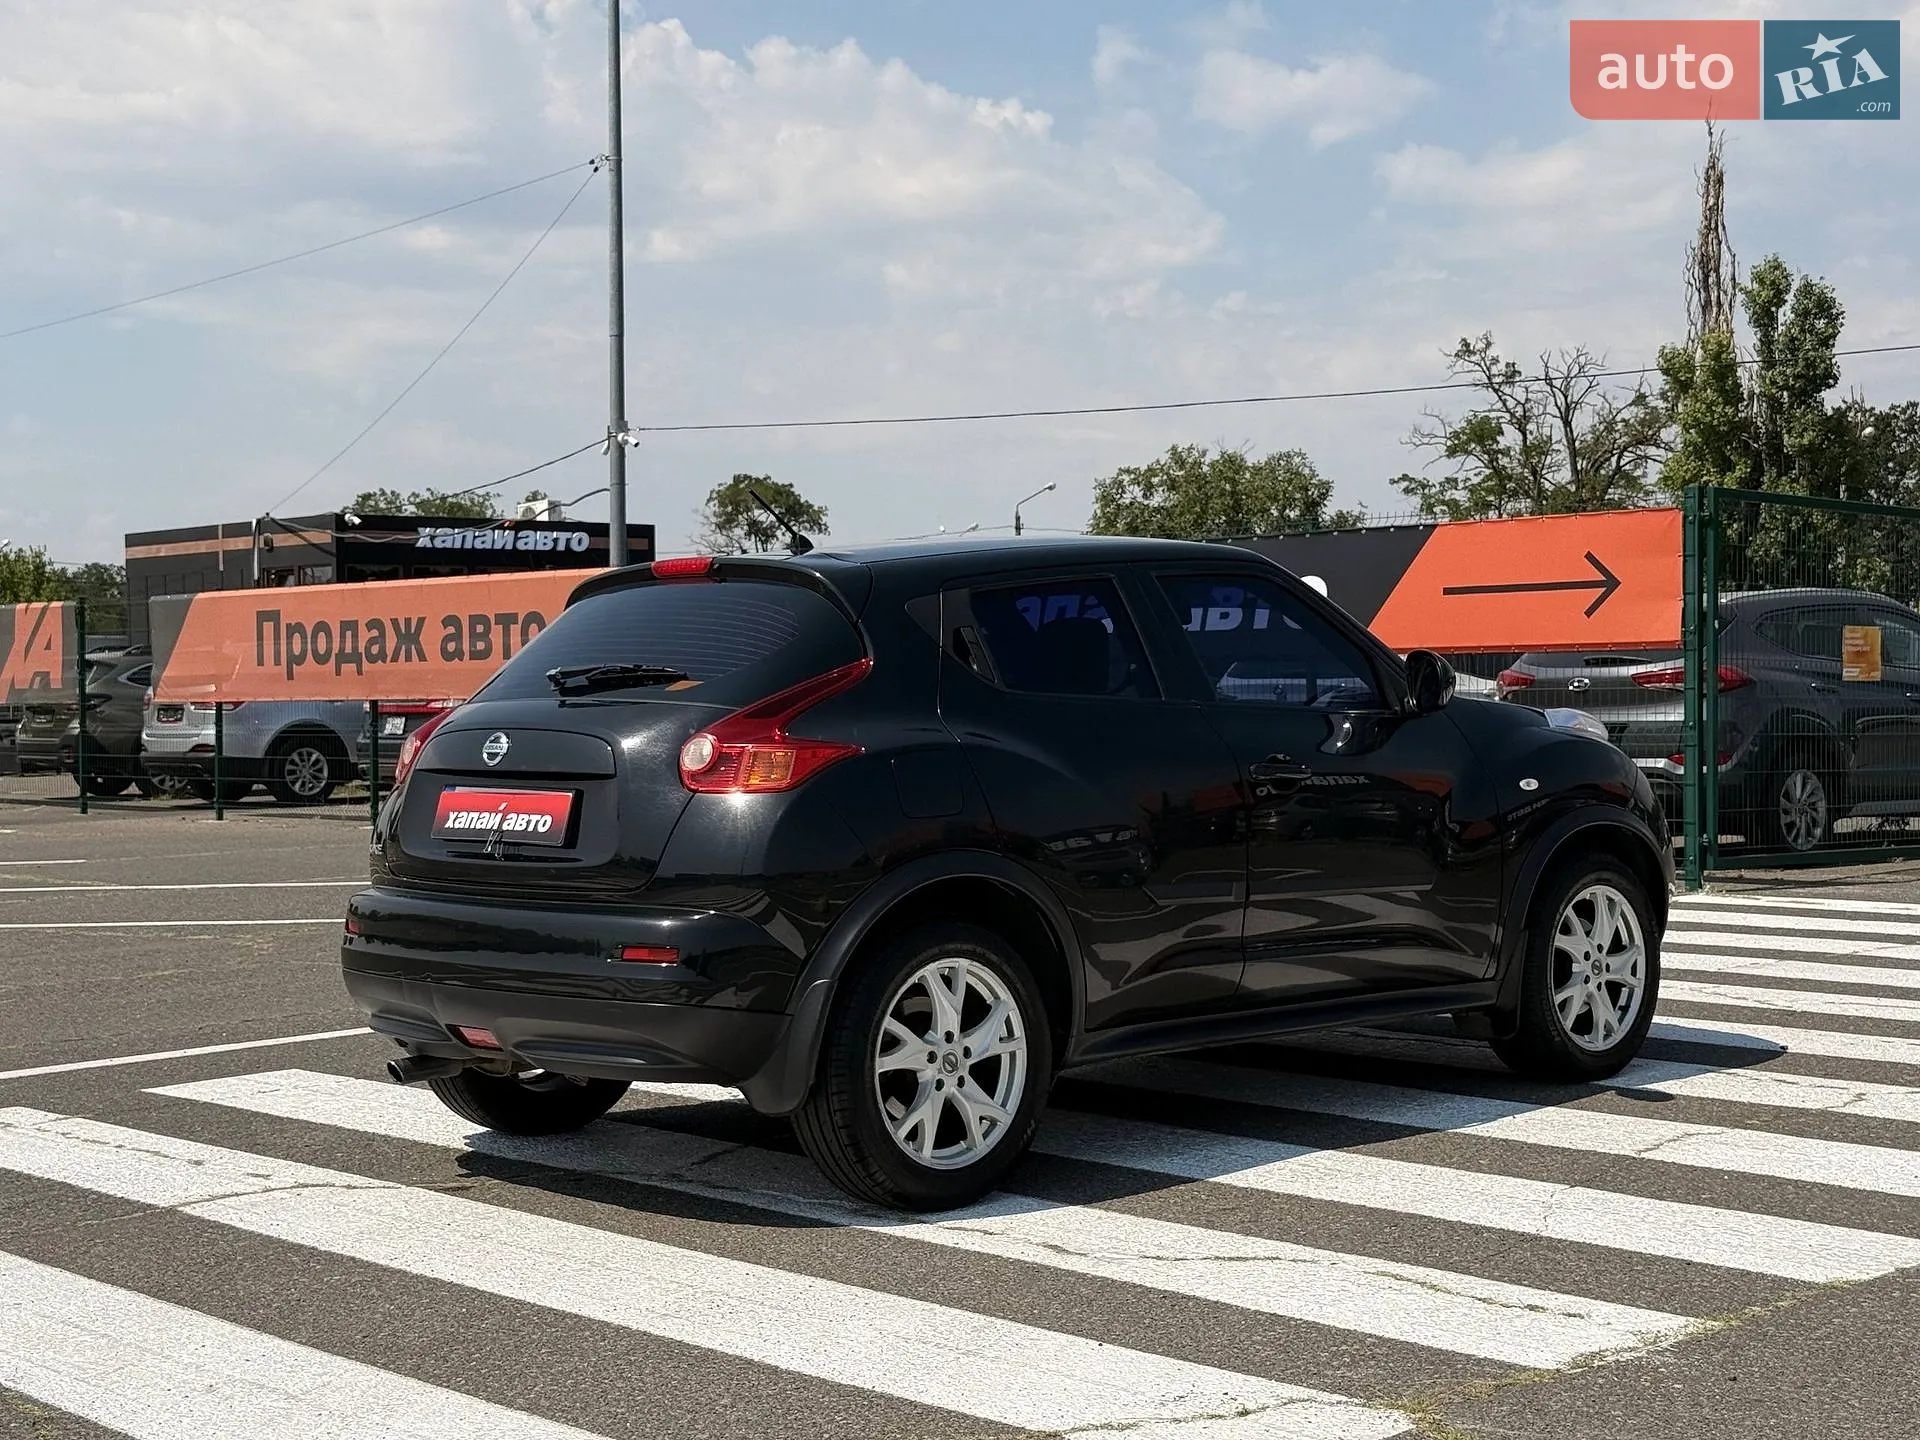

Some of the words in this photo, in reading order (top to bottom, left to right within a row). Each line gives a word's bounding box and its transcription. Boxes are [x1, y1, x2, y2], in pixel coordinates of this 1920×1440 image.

[515, 529, 590, 553] авто
[255, 608, 430, 681] Продаж
[440, 610, 548, 664] авто
[444, 802, 508, 830] хапай
[502, 812, 553, 833] авто
